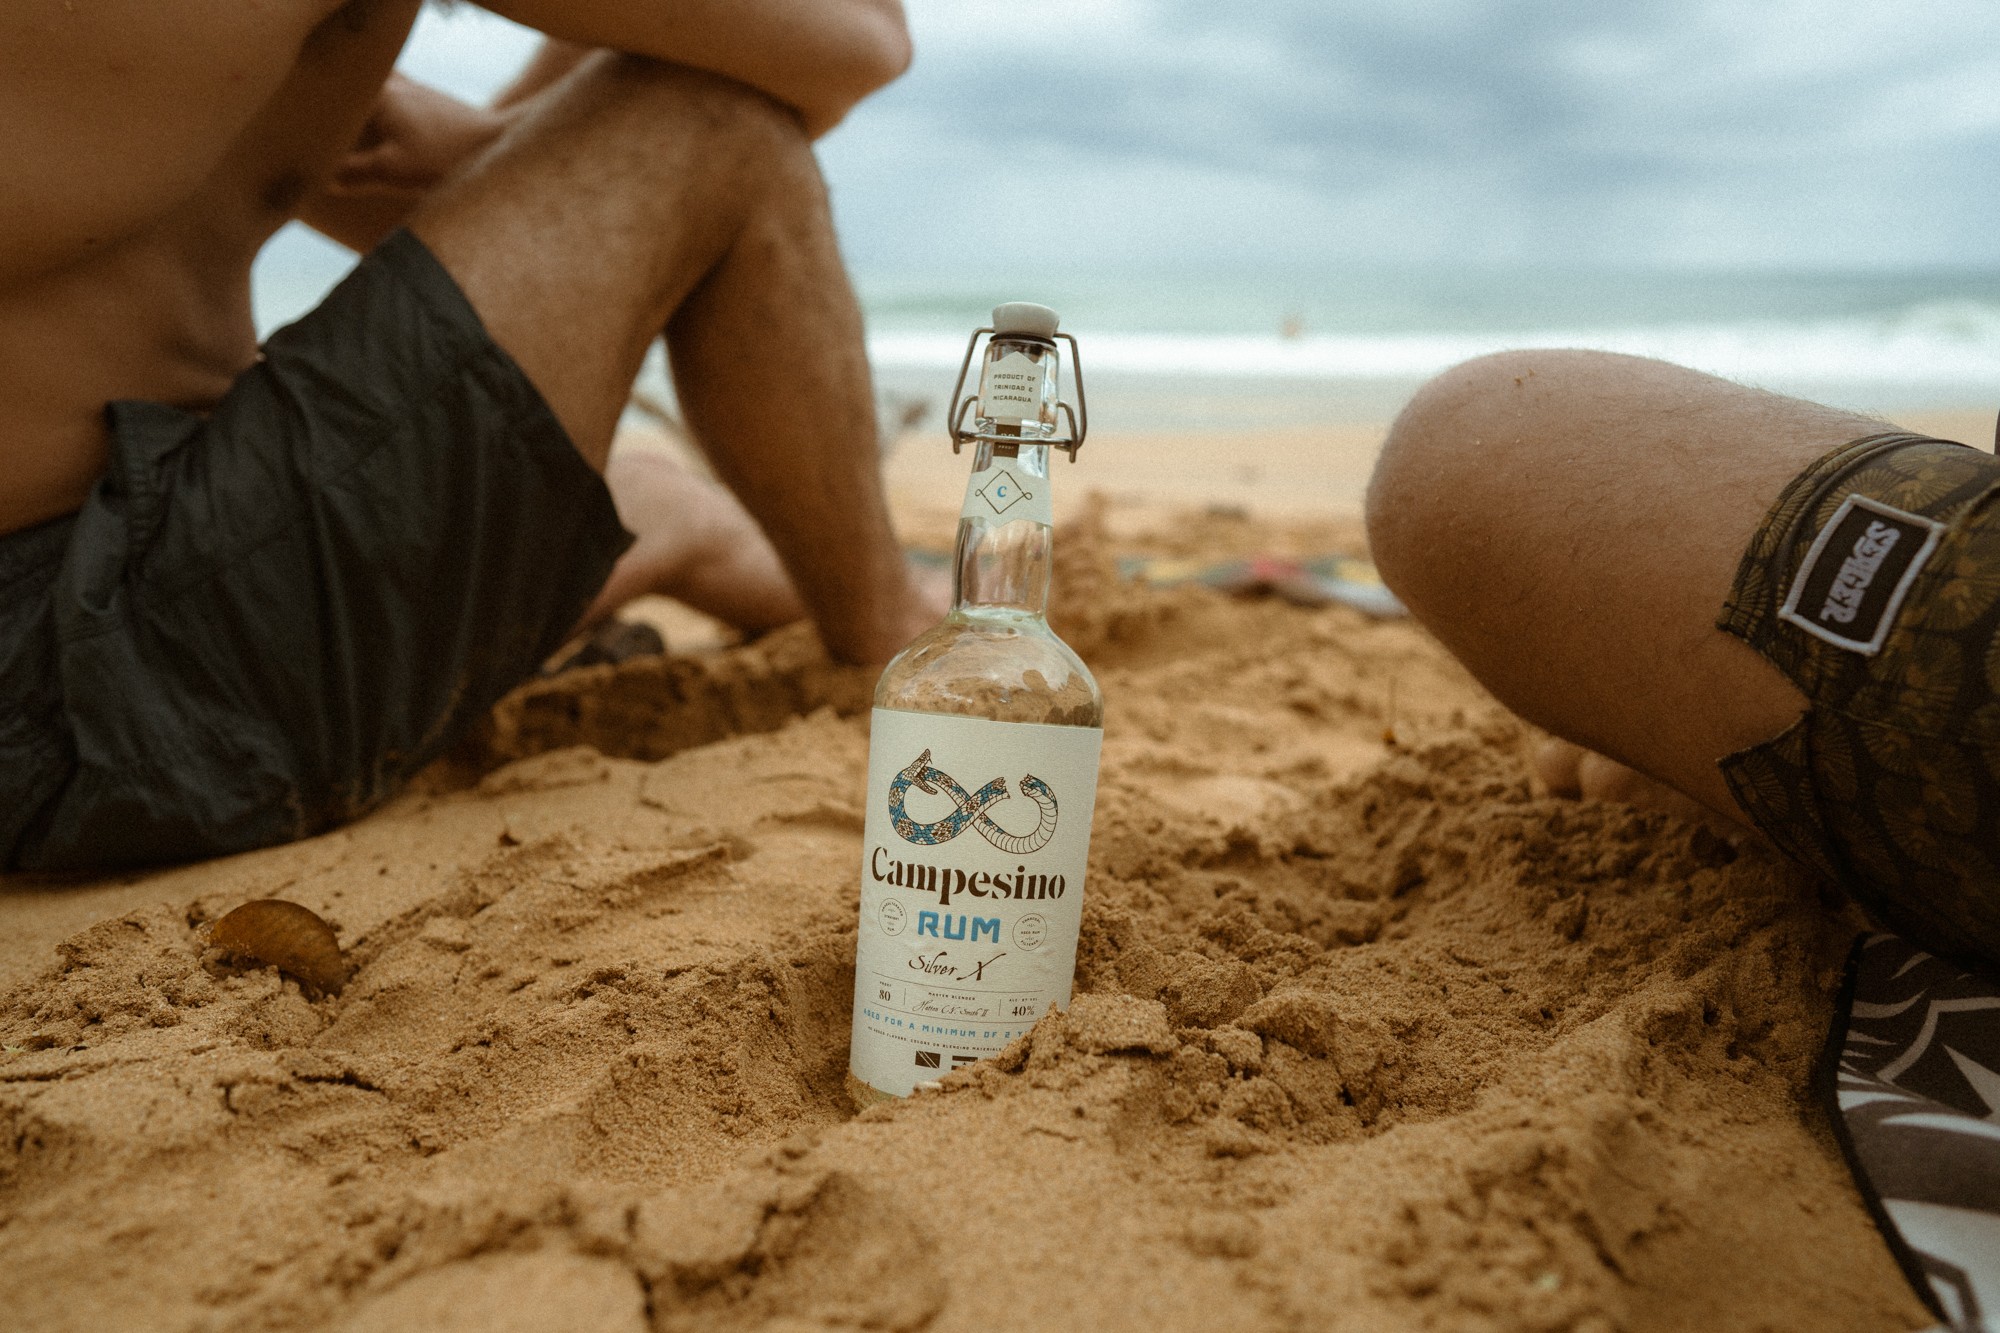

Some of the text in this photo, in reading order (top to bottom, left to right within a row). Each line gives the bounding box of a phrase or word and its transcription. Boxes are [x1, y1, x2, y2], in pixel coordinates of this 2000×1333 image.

[997, 485, 1007, 498] C
[871, 846, 1066, 906] Campesino
[917, 910, 1001, 944] RUM
[908, 951, 1007, 981] Silver X
[879, 989, 891, 1001] 80
[863, 1008, 880, 1020] AGED
[884, 1016, 902, 1027] FOR
[909, 1022, 915, 1030] A
[922, 1024, 976, 1037] MINIMUM
[1011, 1005, 1035, 1017] 40%
